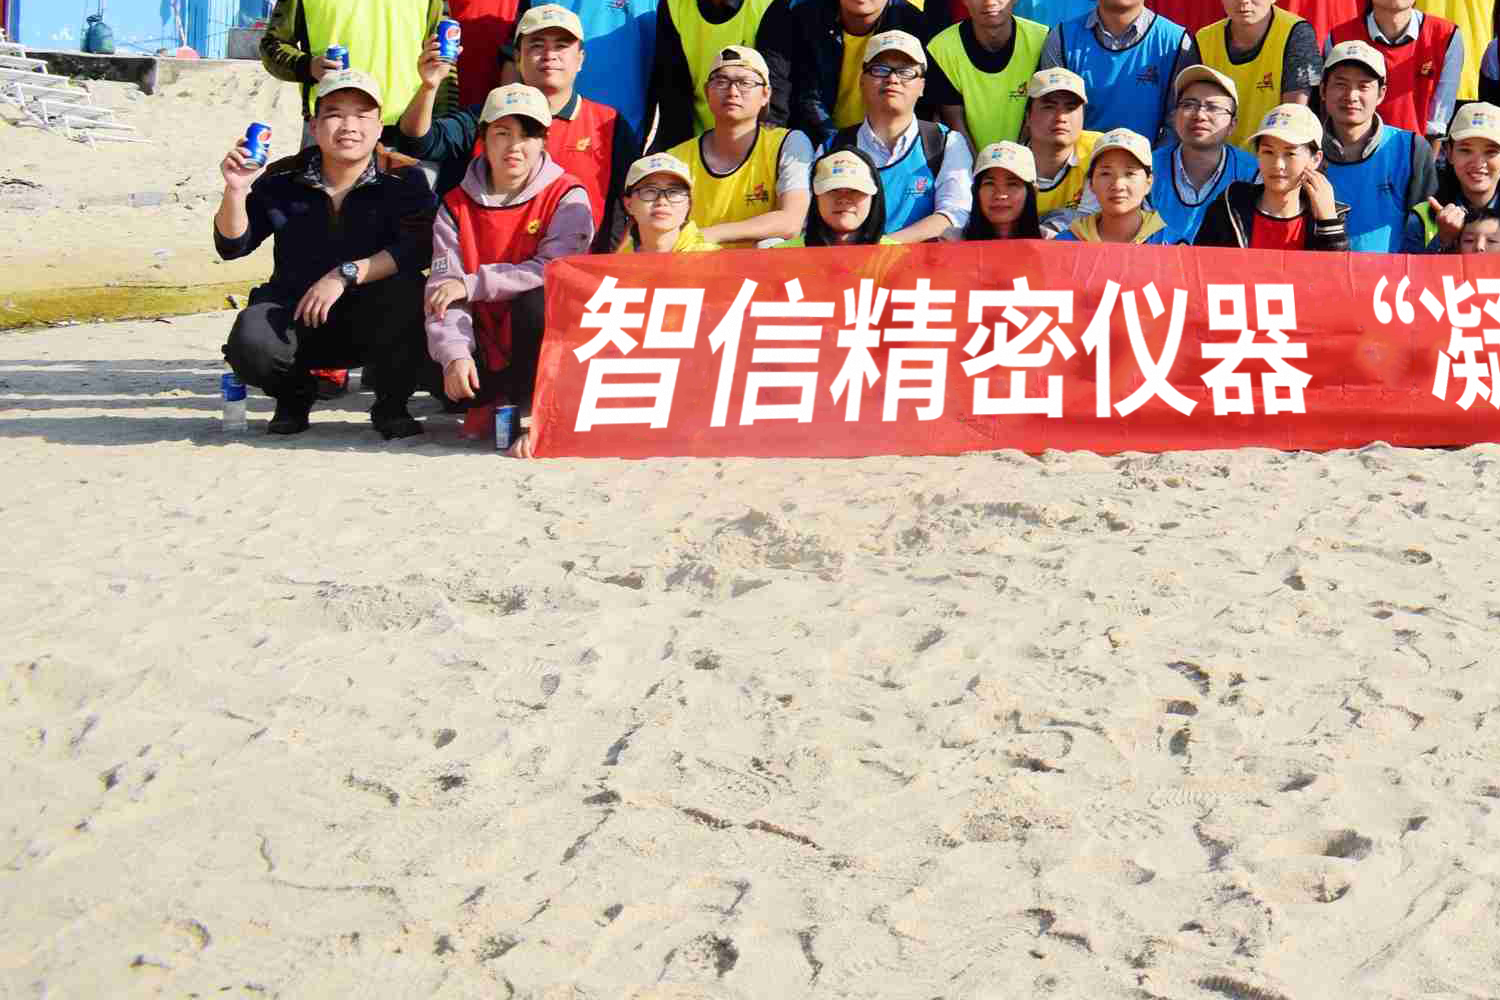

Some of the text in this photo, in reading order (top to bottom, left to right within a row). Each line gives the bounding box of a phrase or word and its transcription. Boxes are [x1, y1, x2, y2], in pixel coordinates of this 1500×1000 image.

[573, 276, 1313, 432] 智信精密仪器
